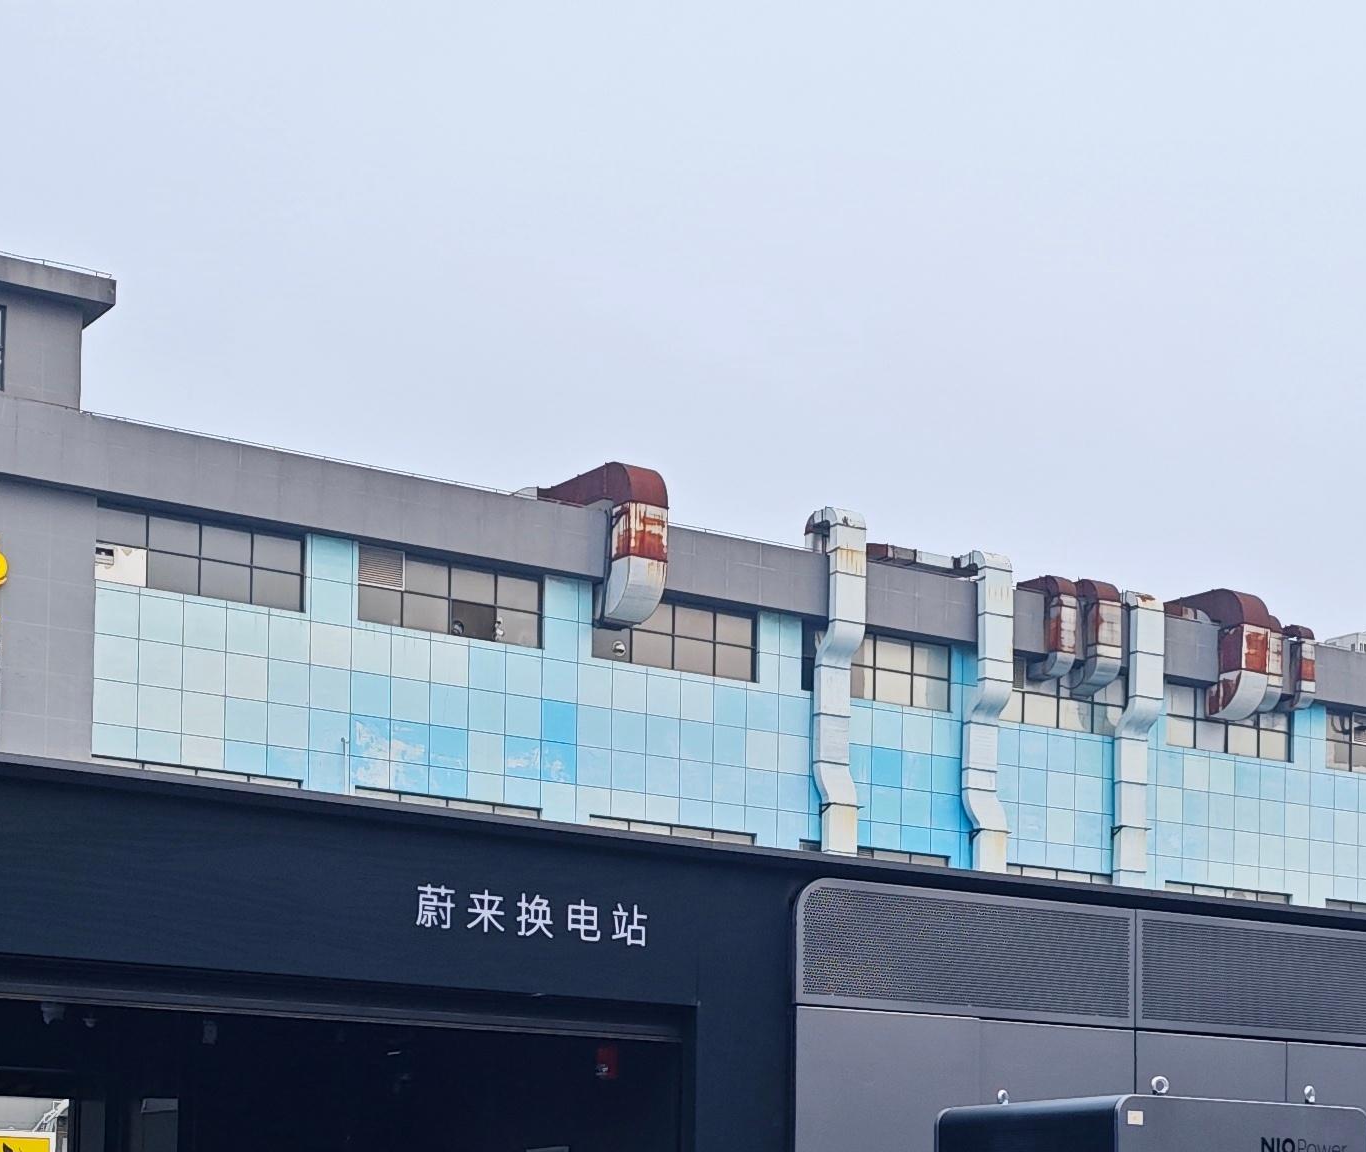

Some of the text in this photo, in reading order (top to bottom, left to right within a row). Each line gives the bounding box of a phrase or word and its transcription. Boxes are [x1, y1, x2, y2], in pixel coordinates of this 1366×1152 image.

[415, 883, 648, 947] 蔚来换电站
